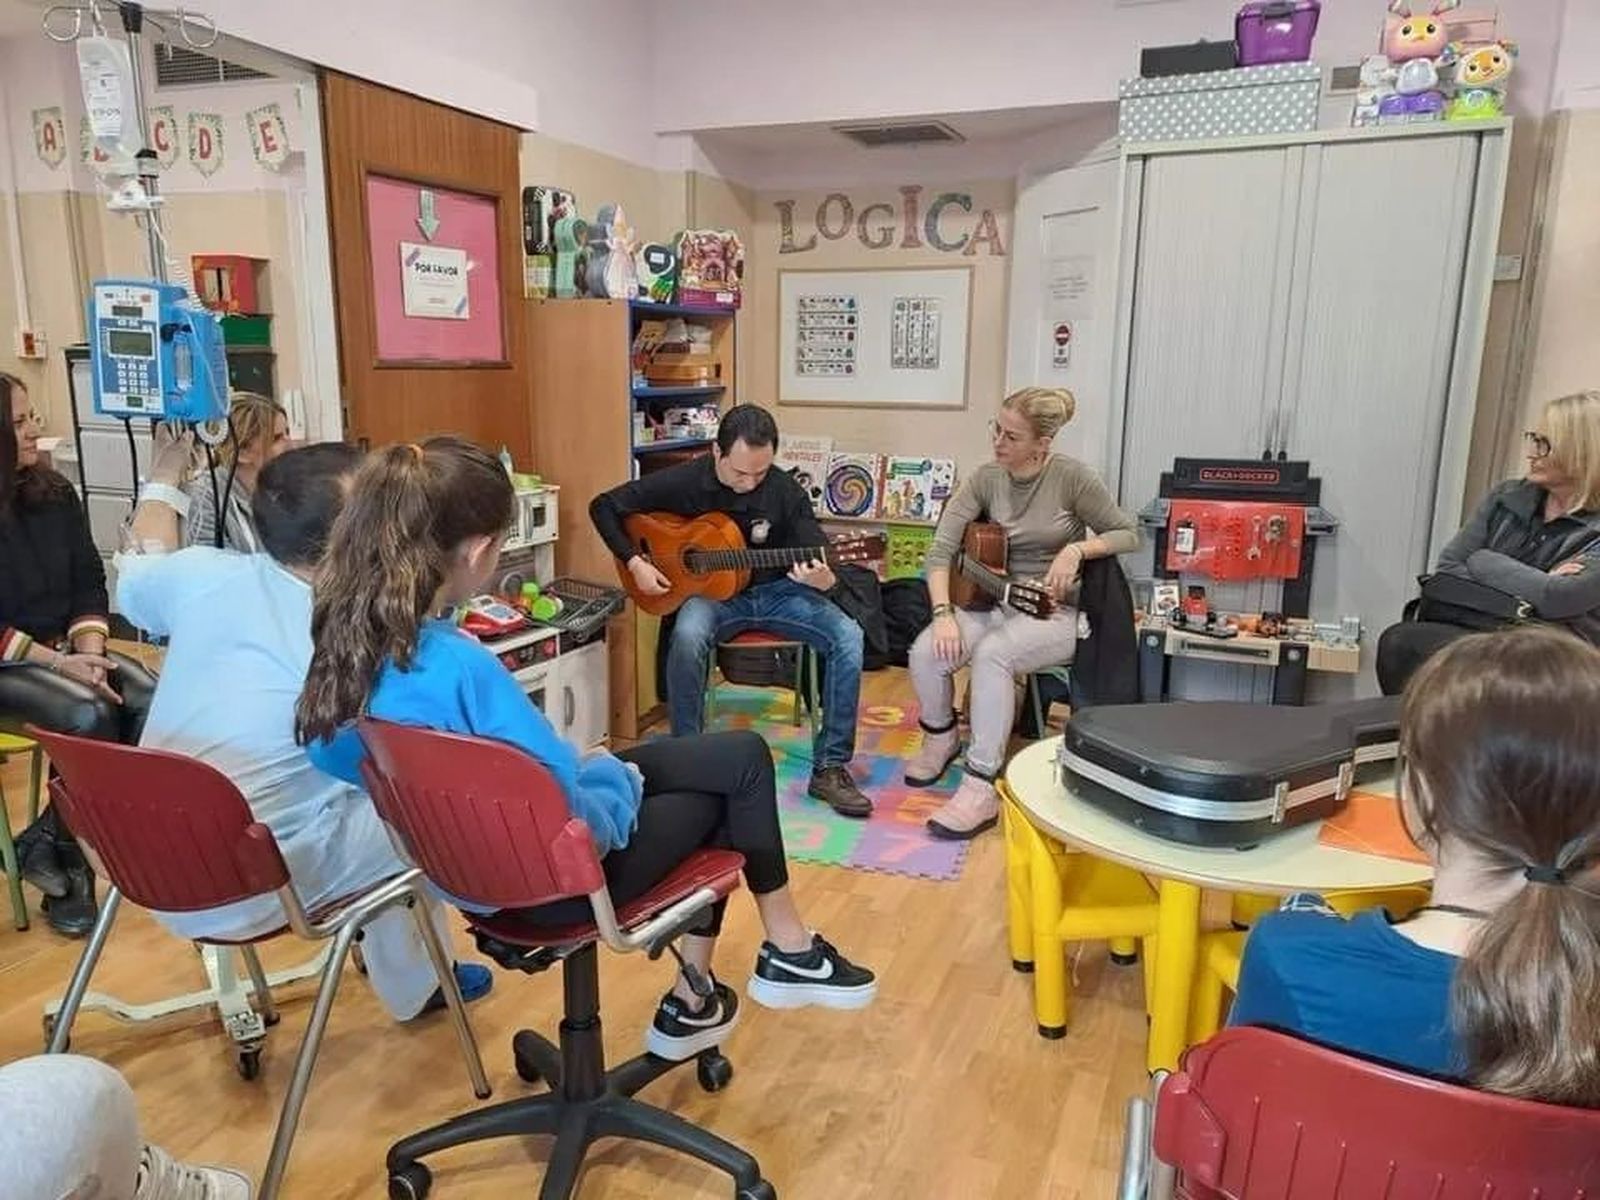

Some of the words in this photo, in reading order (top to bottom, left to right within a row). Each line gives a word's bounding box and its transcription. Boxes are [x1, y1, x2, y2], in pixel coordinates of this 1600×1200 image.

[43, 121, 56, 149] A
[154, 120, 169, 151] C
[199, 127, 212, 159] D
[260, 120, 278, 153] E
[773, 185, 1007, 256] LOGICA
